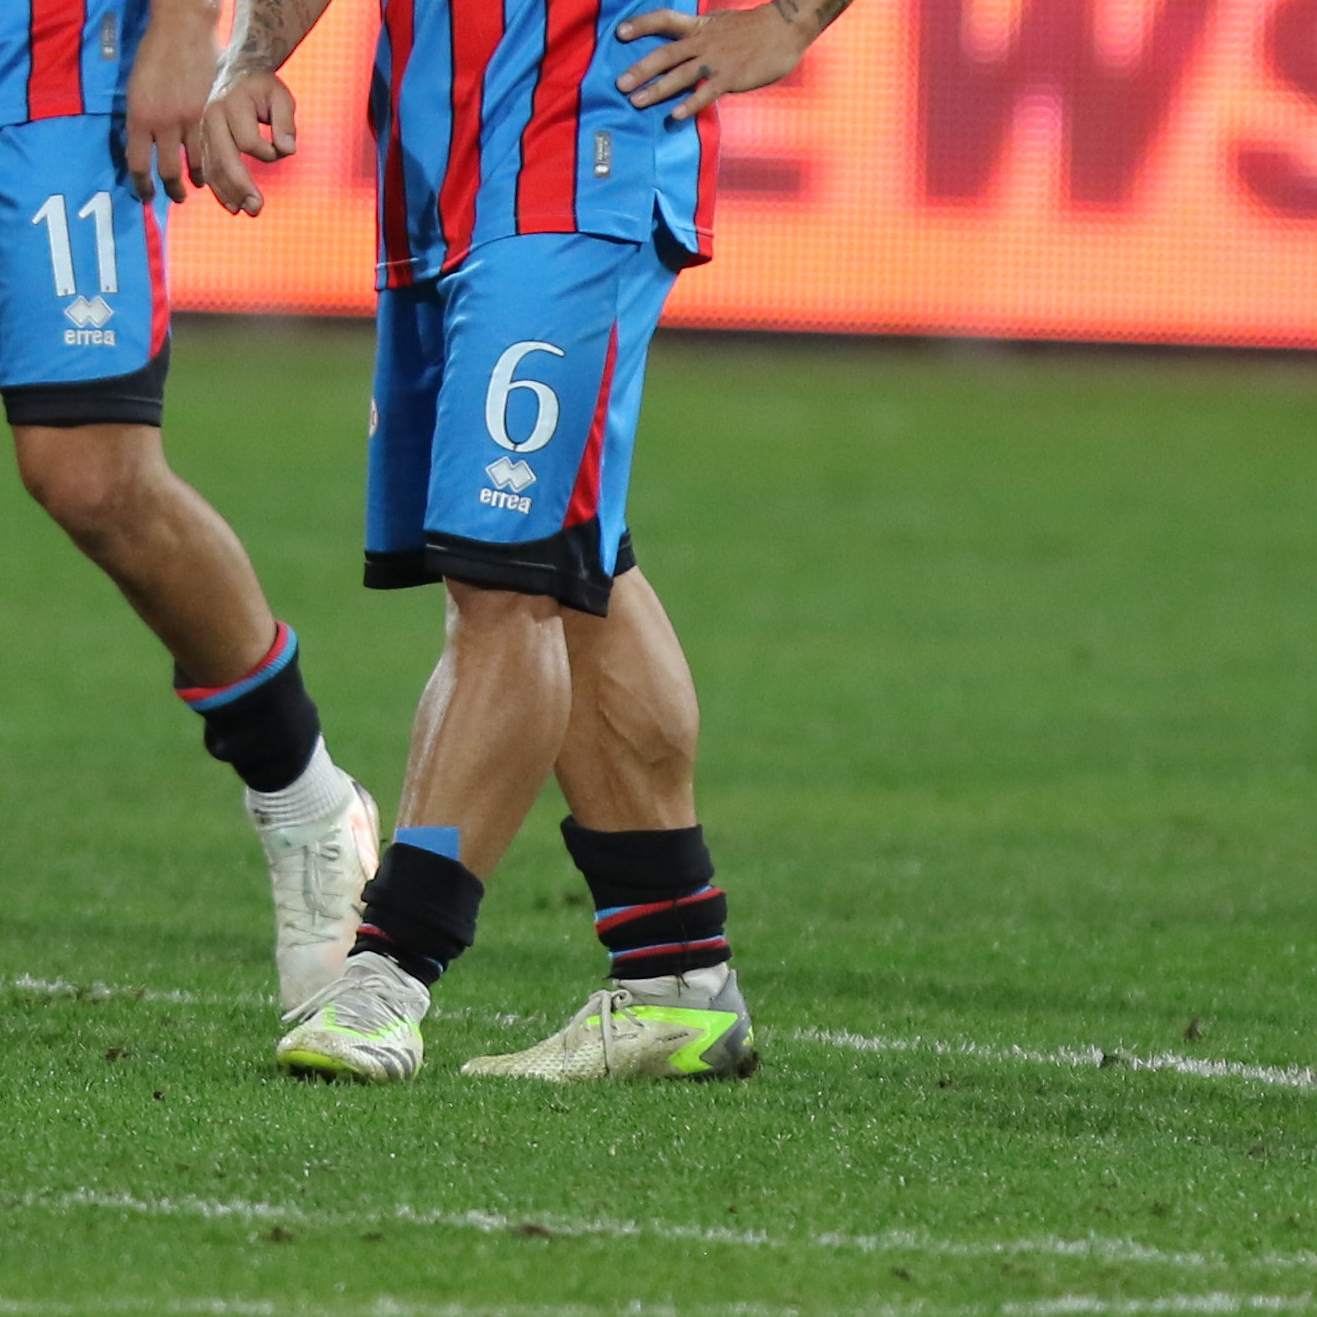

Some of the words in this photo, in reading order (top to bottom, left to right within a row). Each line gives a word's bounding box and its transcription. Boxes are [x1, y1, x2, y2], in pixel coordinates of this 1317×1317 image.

[31, 190, 119, 297] 11
[64, 329, 116, 346] errea
[485, 339, 567, 453] 6
[479, 487, 533, 515] errea
